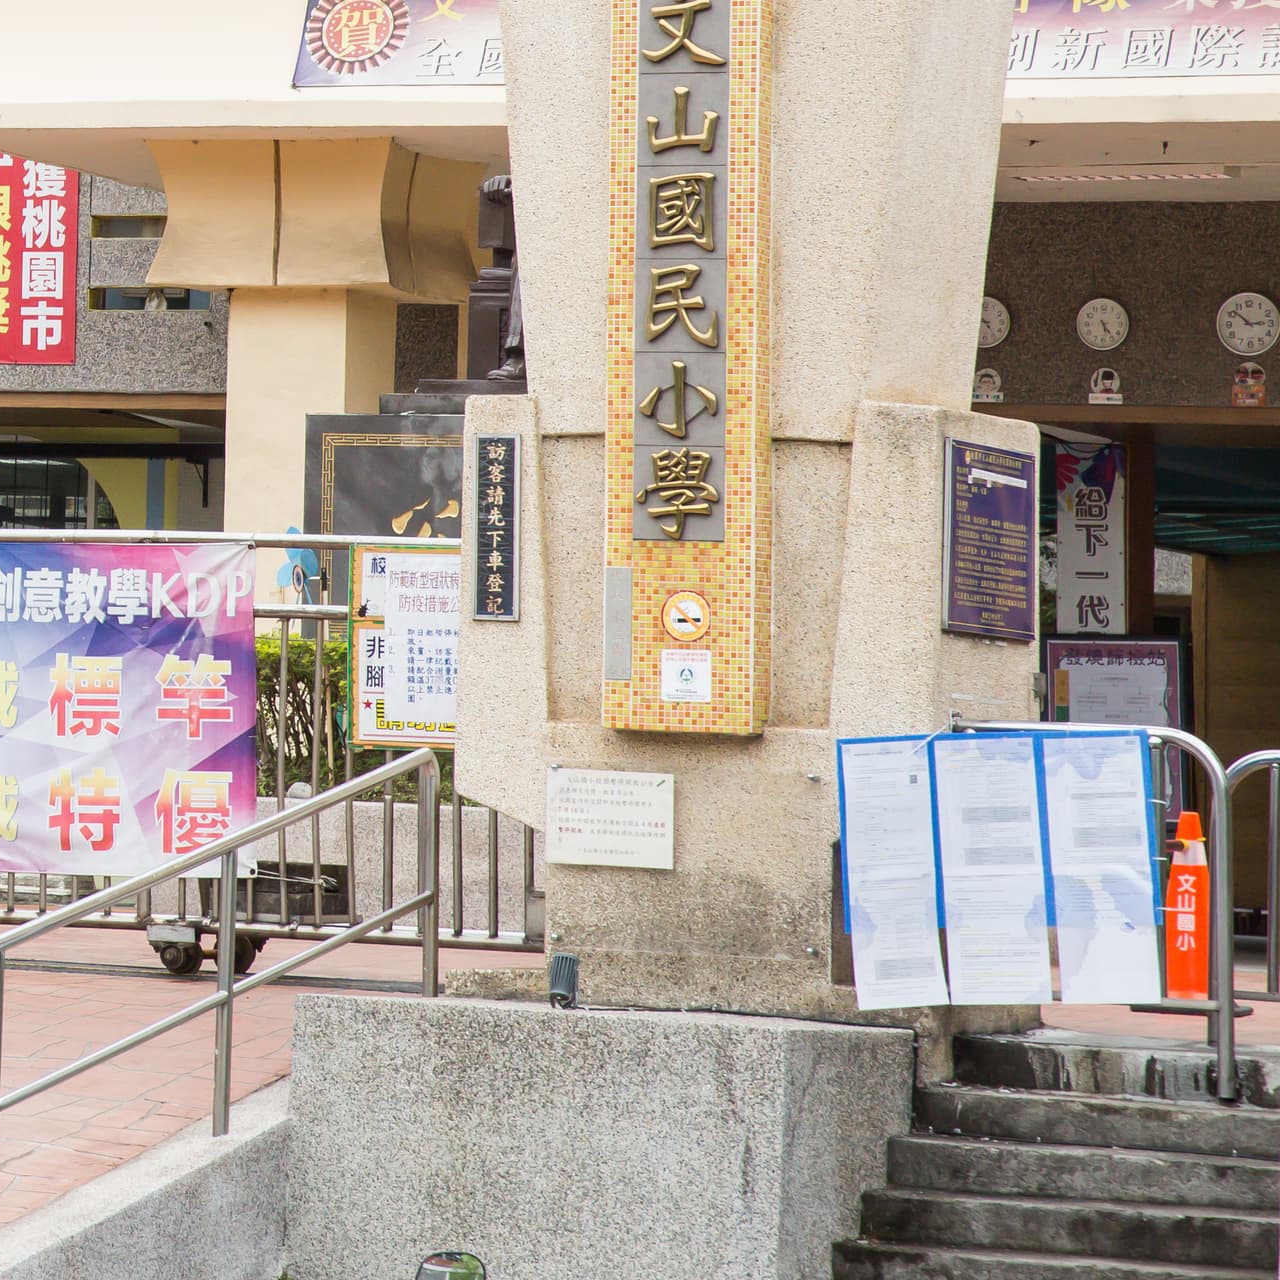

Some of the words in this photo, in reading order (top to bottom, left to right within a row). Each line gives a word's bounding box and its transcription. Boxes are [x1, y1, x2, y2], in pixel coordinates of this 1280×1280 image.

[335, 7, 385, 58] 賀
[486, 442, 506, 615] 訪客請先下車登記
